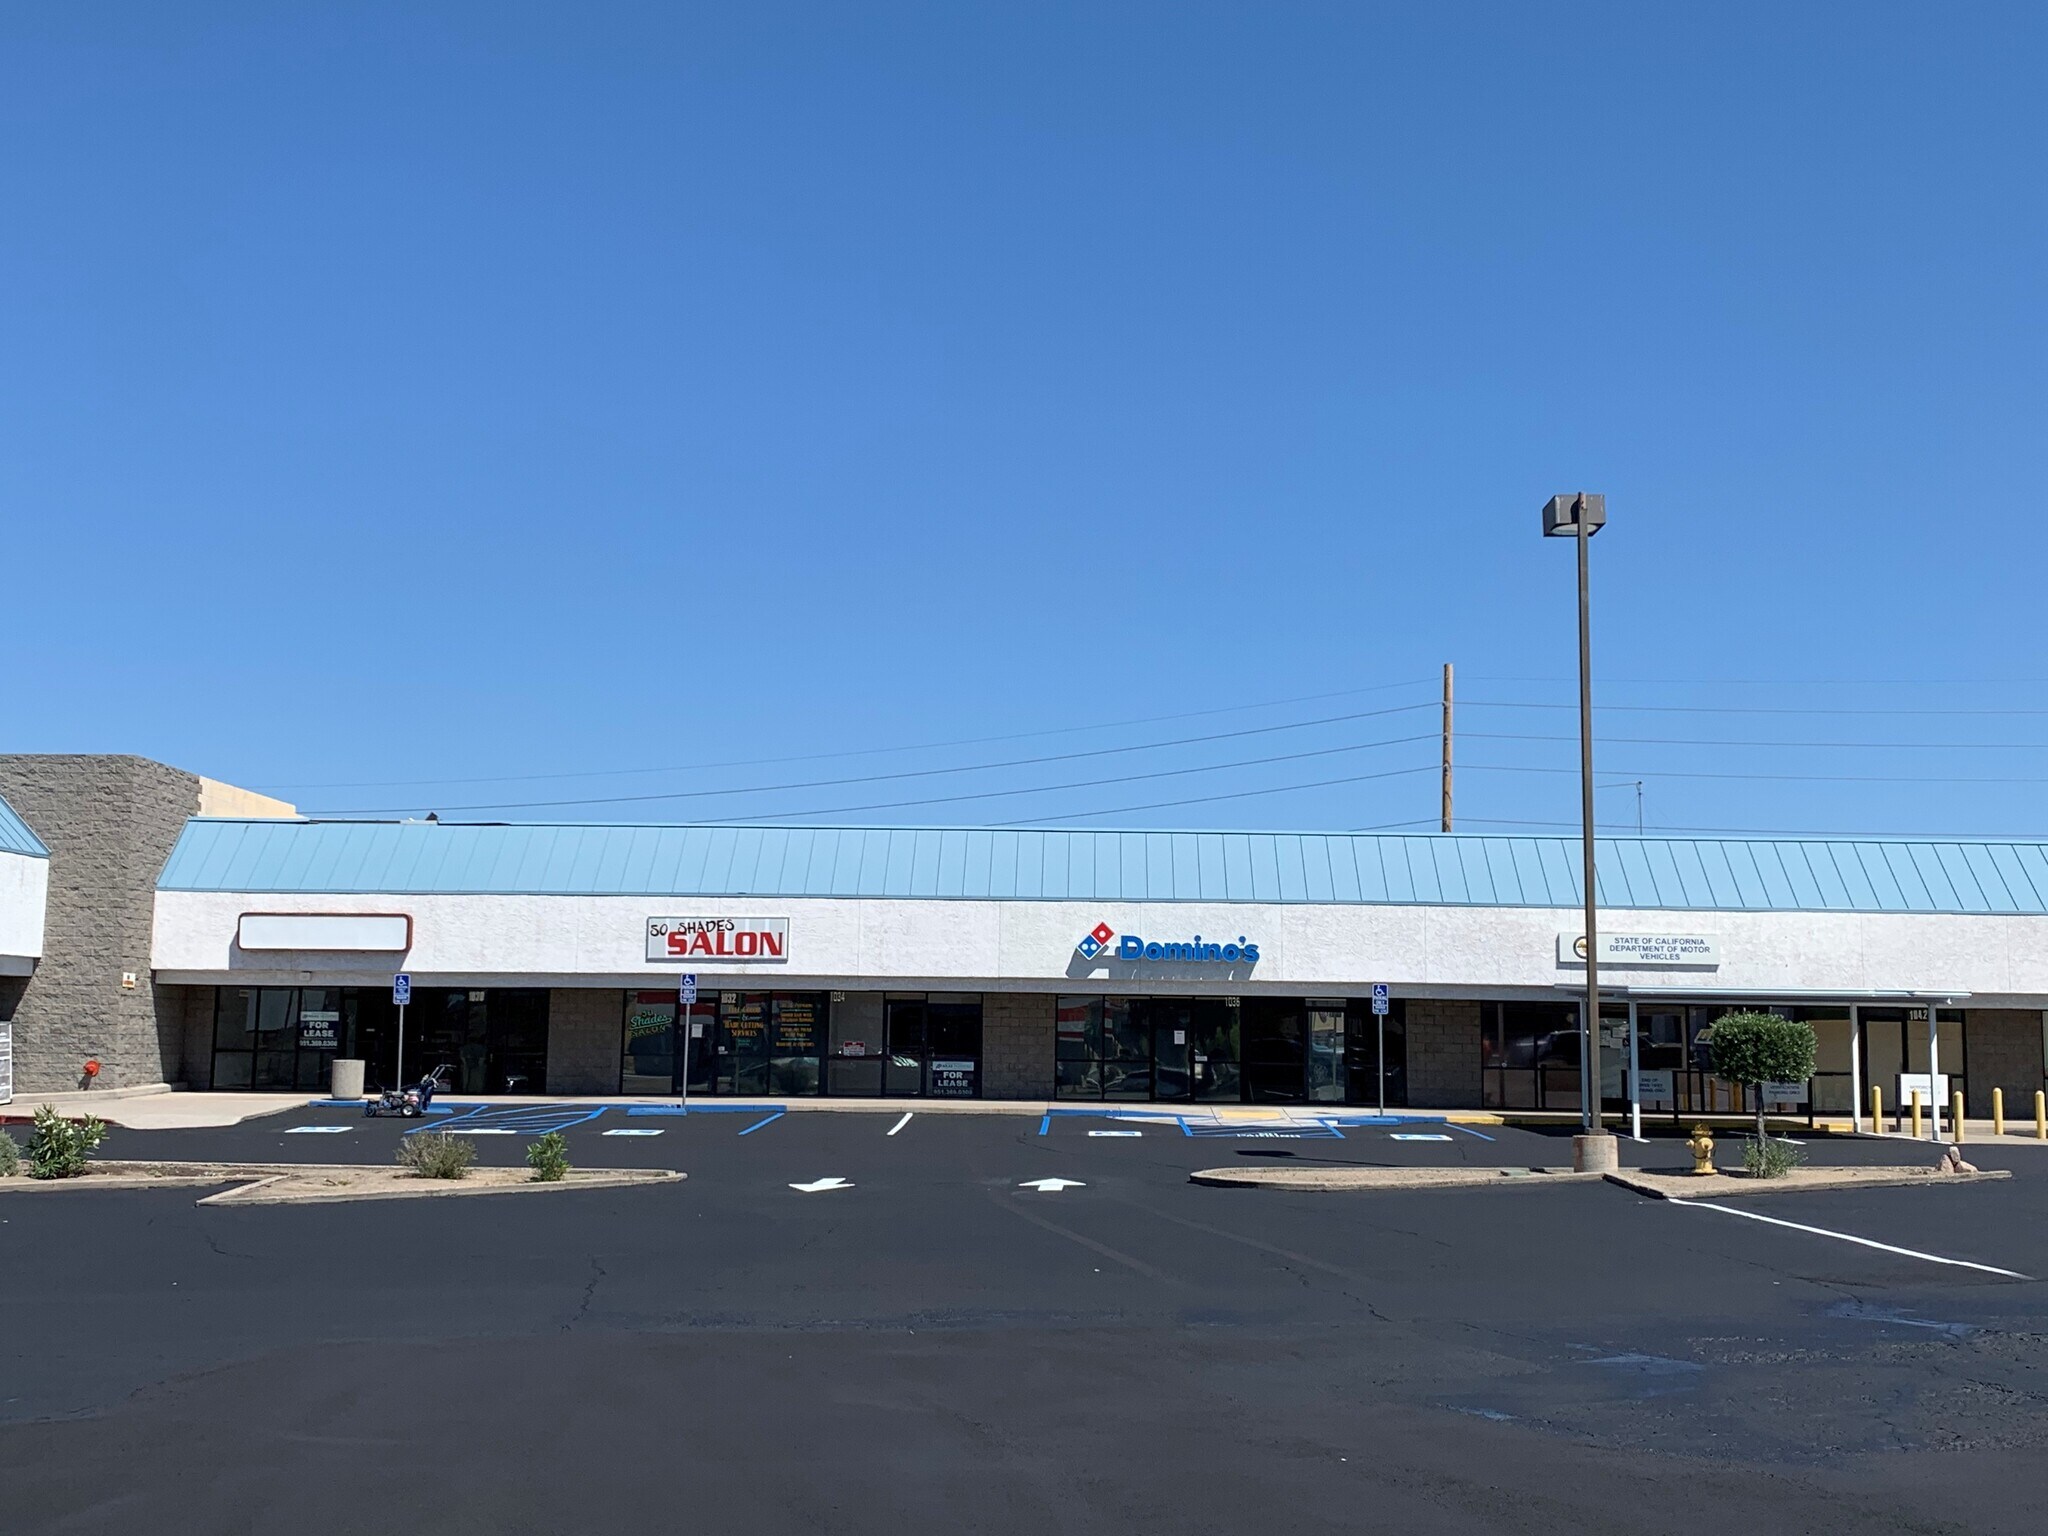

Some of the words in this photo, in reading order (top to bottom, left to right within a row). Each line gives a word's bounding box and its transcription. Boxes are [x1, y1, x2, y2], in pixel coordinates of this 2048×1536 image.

[649, 923, 668, 937] 50
[677, 918, 735, 935] SHADES
[667, 931, 784, 956] SALON
[1614, 937, 1640, 945] STATE
[1642, 937, 1653, 945] OF
[1655, 938, 1706, 946] CALIFORNIA
[1120, 934, 1260, 963] Domino's
[1609, 945, 1665, 953] DEPARTMENT
[1667, 945, 1678, 953] OF
[1680, 945, 1711, 953] MOTOR
[1639, 953, 1681, 961] VEHICLES
[721, 993, 737, 1004] 1032
[830, 991, 846, 1002] 1034
[1225, 996, 1241, 1008] 1036
[1909, 1009, 1928, 1020] 1042
[309, 1021, 329, 1029] FOR
[630, 1013, 668, 1028] Shades
[303, 1029, 335, 1038] LEASE
[943, 1071, 963, 1079] FOR
[937, 1079, 969, 1087] LEASE
